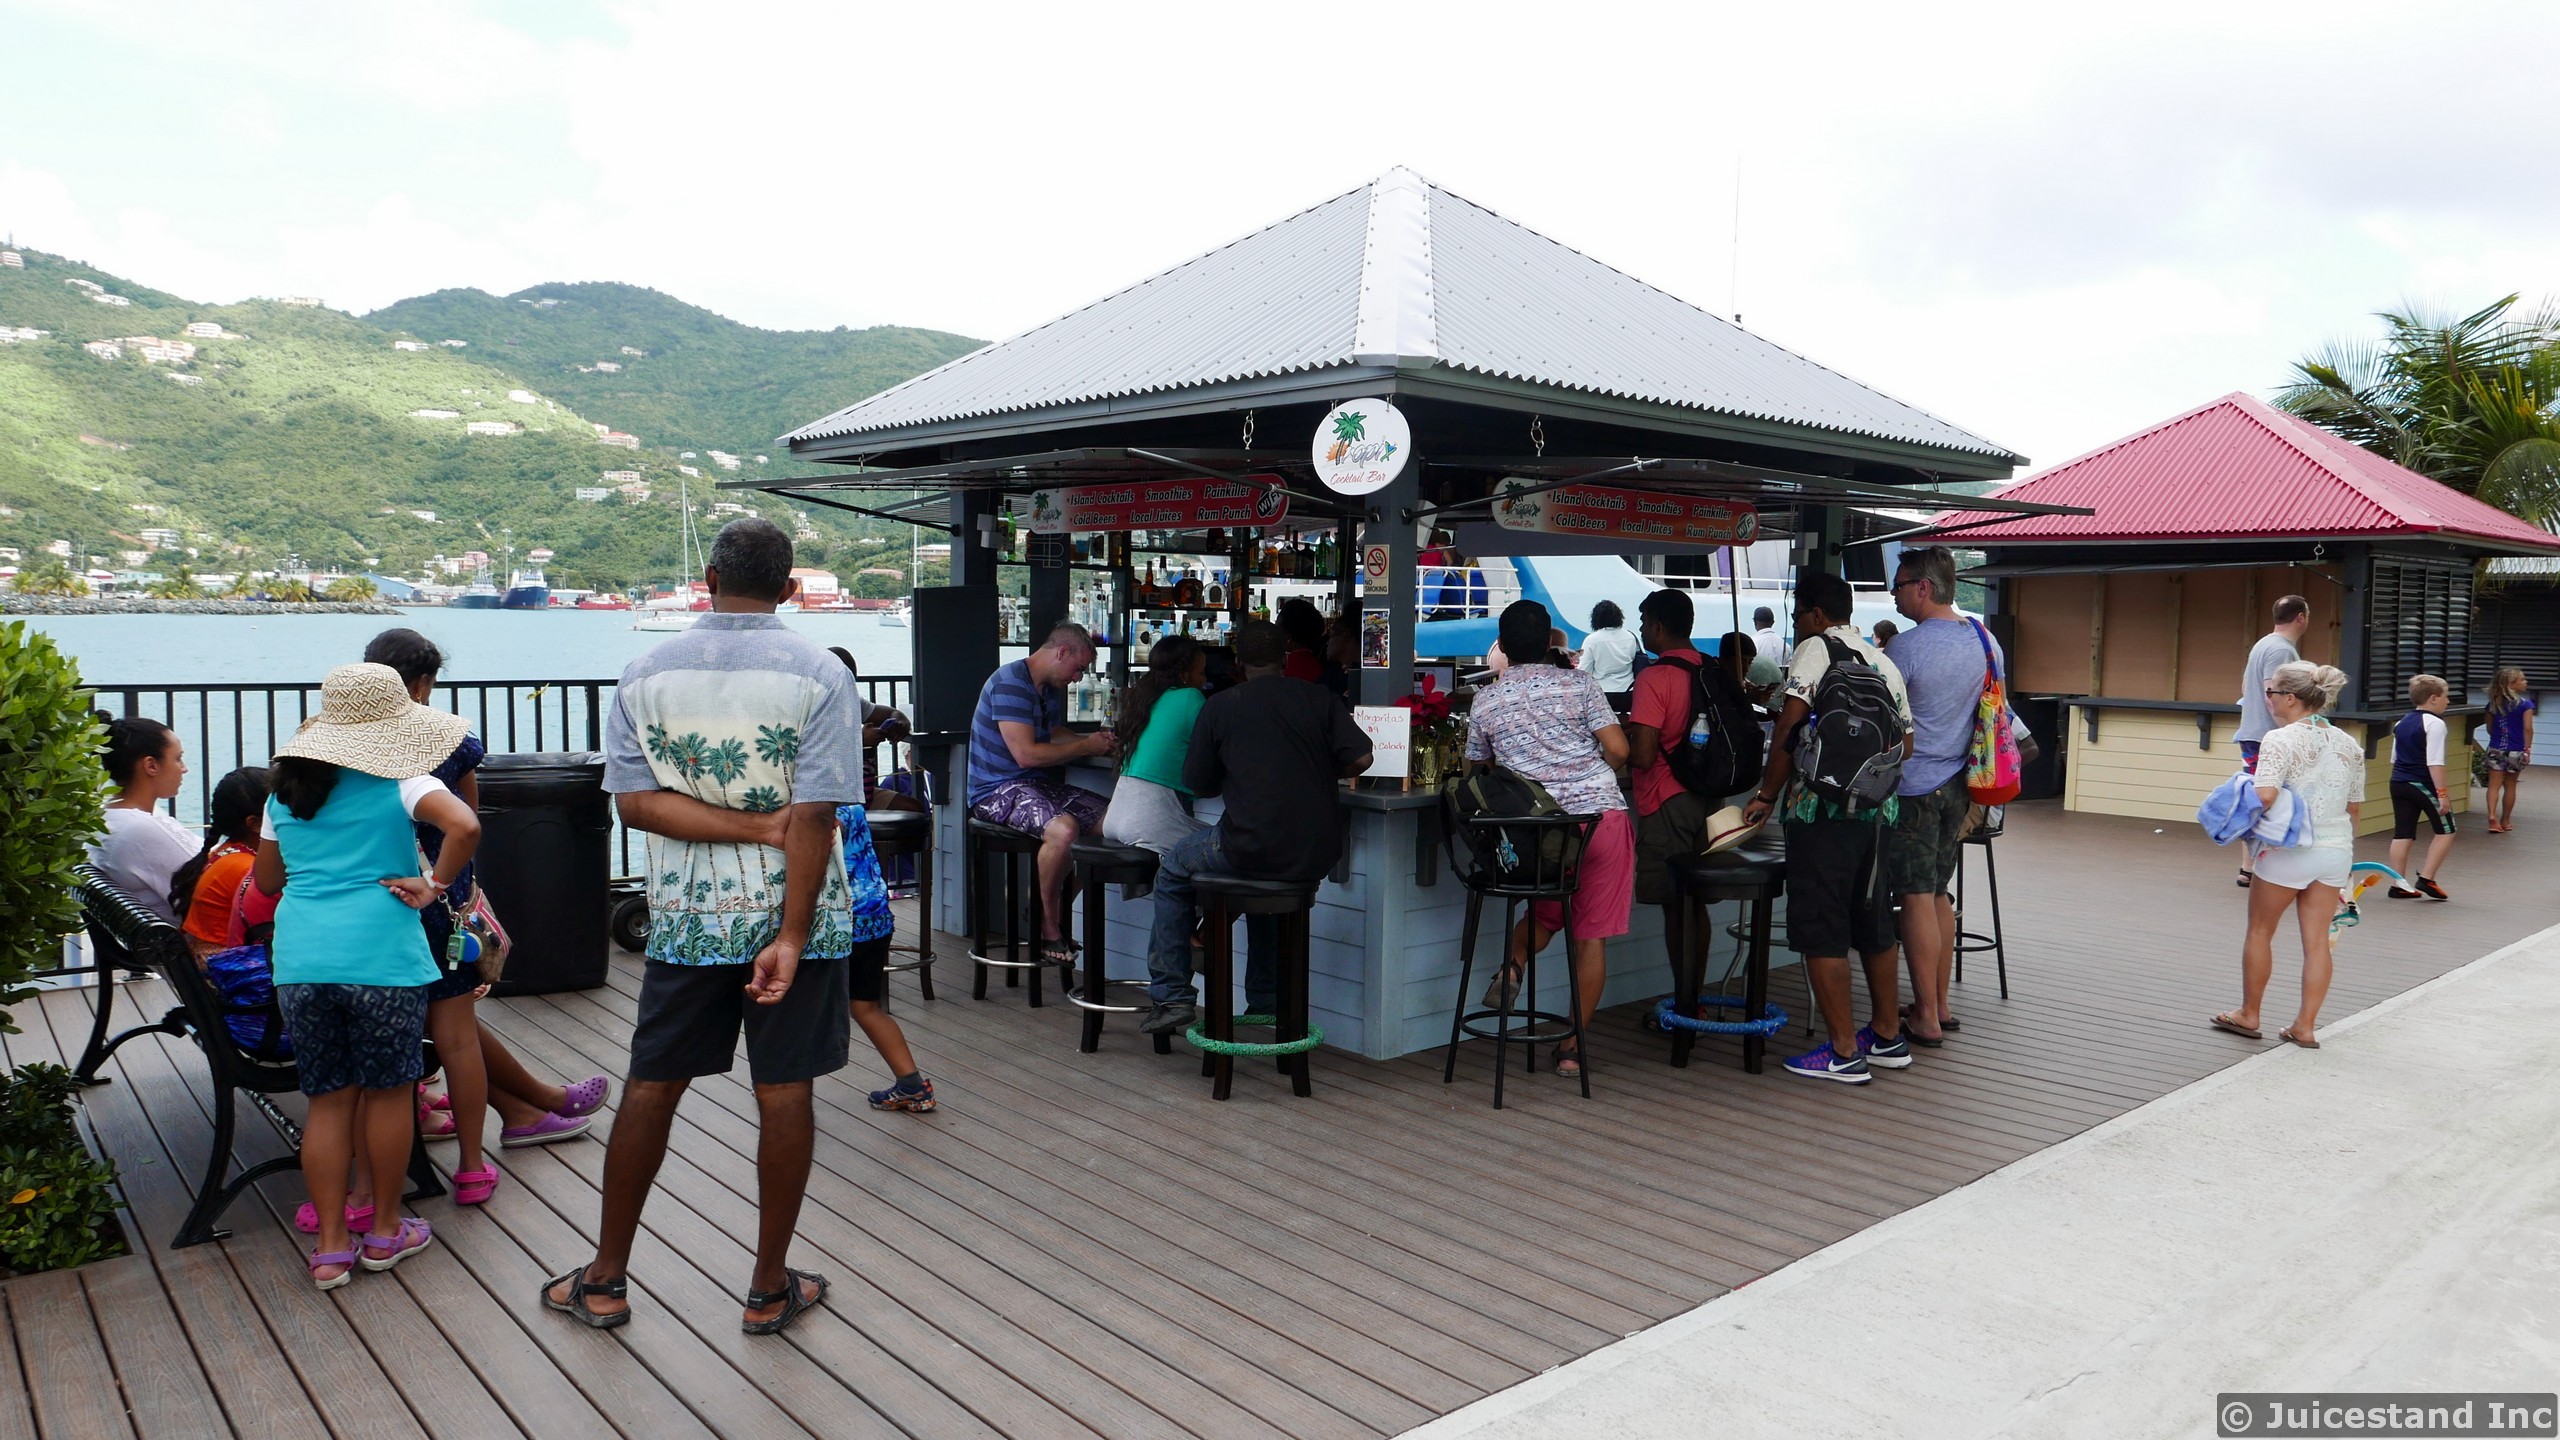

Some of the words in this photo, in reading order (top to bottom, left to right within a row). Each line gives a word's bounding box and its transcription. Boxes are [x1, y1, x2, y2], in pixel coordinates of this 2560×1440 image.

[1330, 472, 1364, 485] Cocktail
[1366, 470, 1386, 482] Bar
[1071, 491, 1096, 506] Island
[1097, 489, 1135, 504] Cocktails
[1145, 486, 1192, 502] Smoothies
[1204, 482, 1251, 499] Painkiller
[1552, 490, 1581, 505] Island
[1583, 492, 1627, 510] Cocktails
[1637, 499, 1682, 515] Smoothies
[1691, 504, 1733, 519] Painkiller
[1073, 512, 1090, 525] Cold
[1093, 511, 1117, 524] Beers
[1130, 508, 1153, 524] Local
[1155, 508, 1182, 522] Juices
[1197, 506, 1219, 520] Rum
[1222, 504, 1251, 520] Punch
[1555, 512, 1577, 527] Cold
[1579, 515, 1607, 530] Beers
[1621, 518, 1645, 532] Local
[1646, 520, 1673, 536] Juices
[1686, 524, 1705, 538] Rum
[1707, 526, 1732, 540] Punch
[1364, 585, 1388, 593] SMOKING
[1356, 710, 1404, 725] Margaritas
[1378, 742, 1406, 751] Colada
